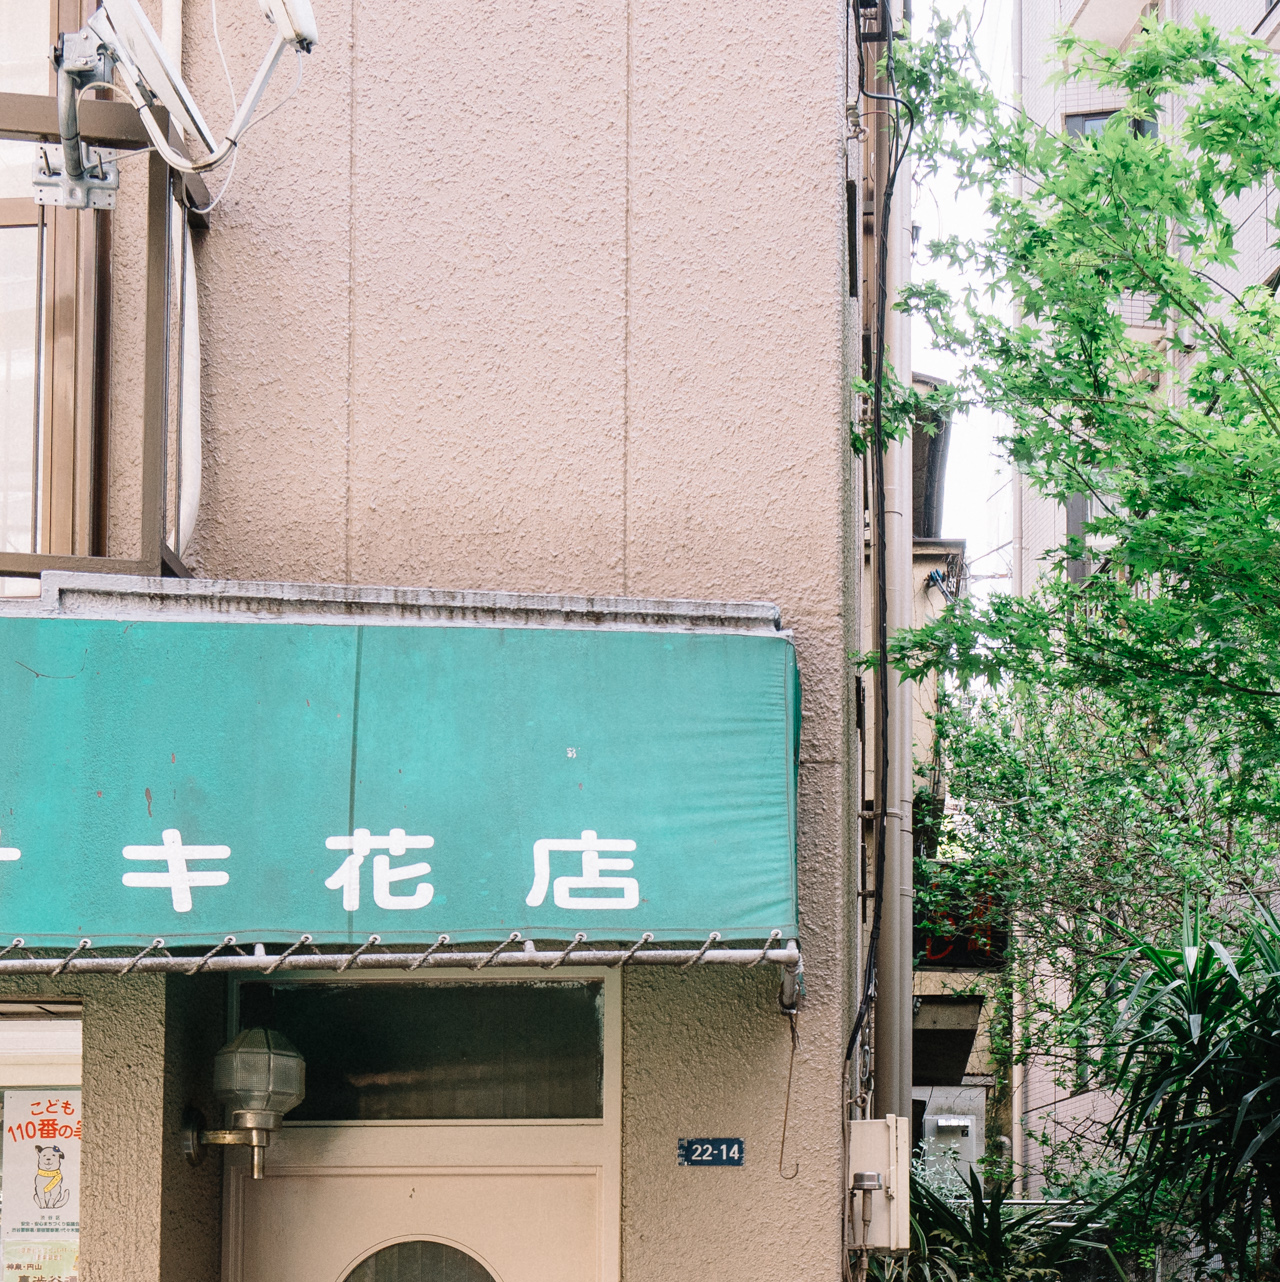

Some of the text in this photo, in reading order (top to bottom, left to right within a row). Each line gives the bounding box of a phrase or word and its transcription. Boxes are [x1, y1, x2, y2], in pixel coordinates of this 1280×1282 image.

[30, 1099, 75, 1116] こども
[691, 1144, 740, 1160] 22-14
